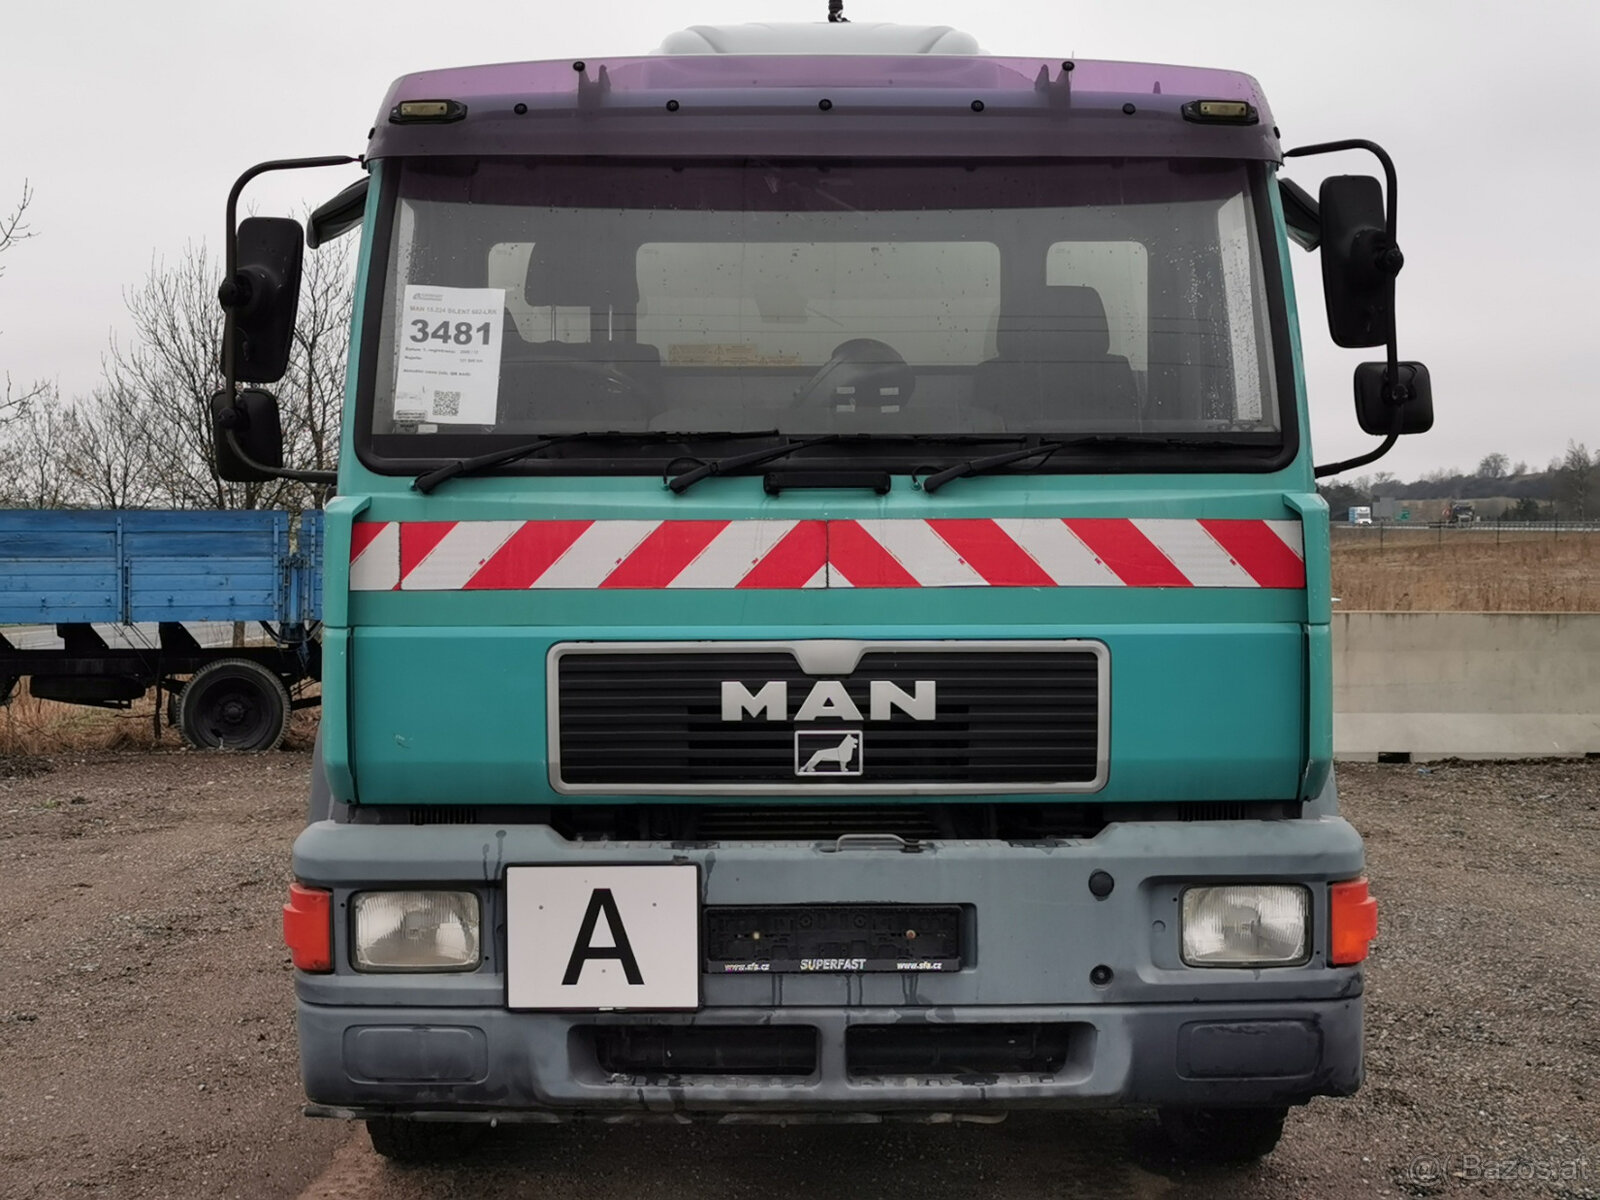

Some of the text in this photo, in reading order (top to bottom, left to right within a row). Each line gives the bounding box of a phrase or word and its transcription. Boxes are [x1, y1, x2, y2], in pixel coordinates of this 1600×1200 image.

[410, 319, 491, 345] 3481
[721, 681, 936, 721] MAN
[561, 888, 645, 985] A
[800, 959, 867, 970] SUPERFAST
